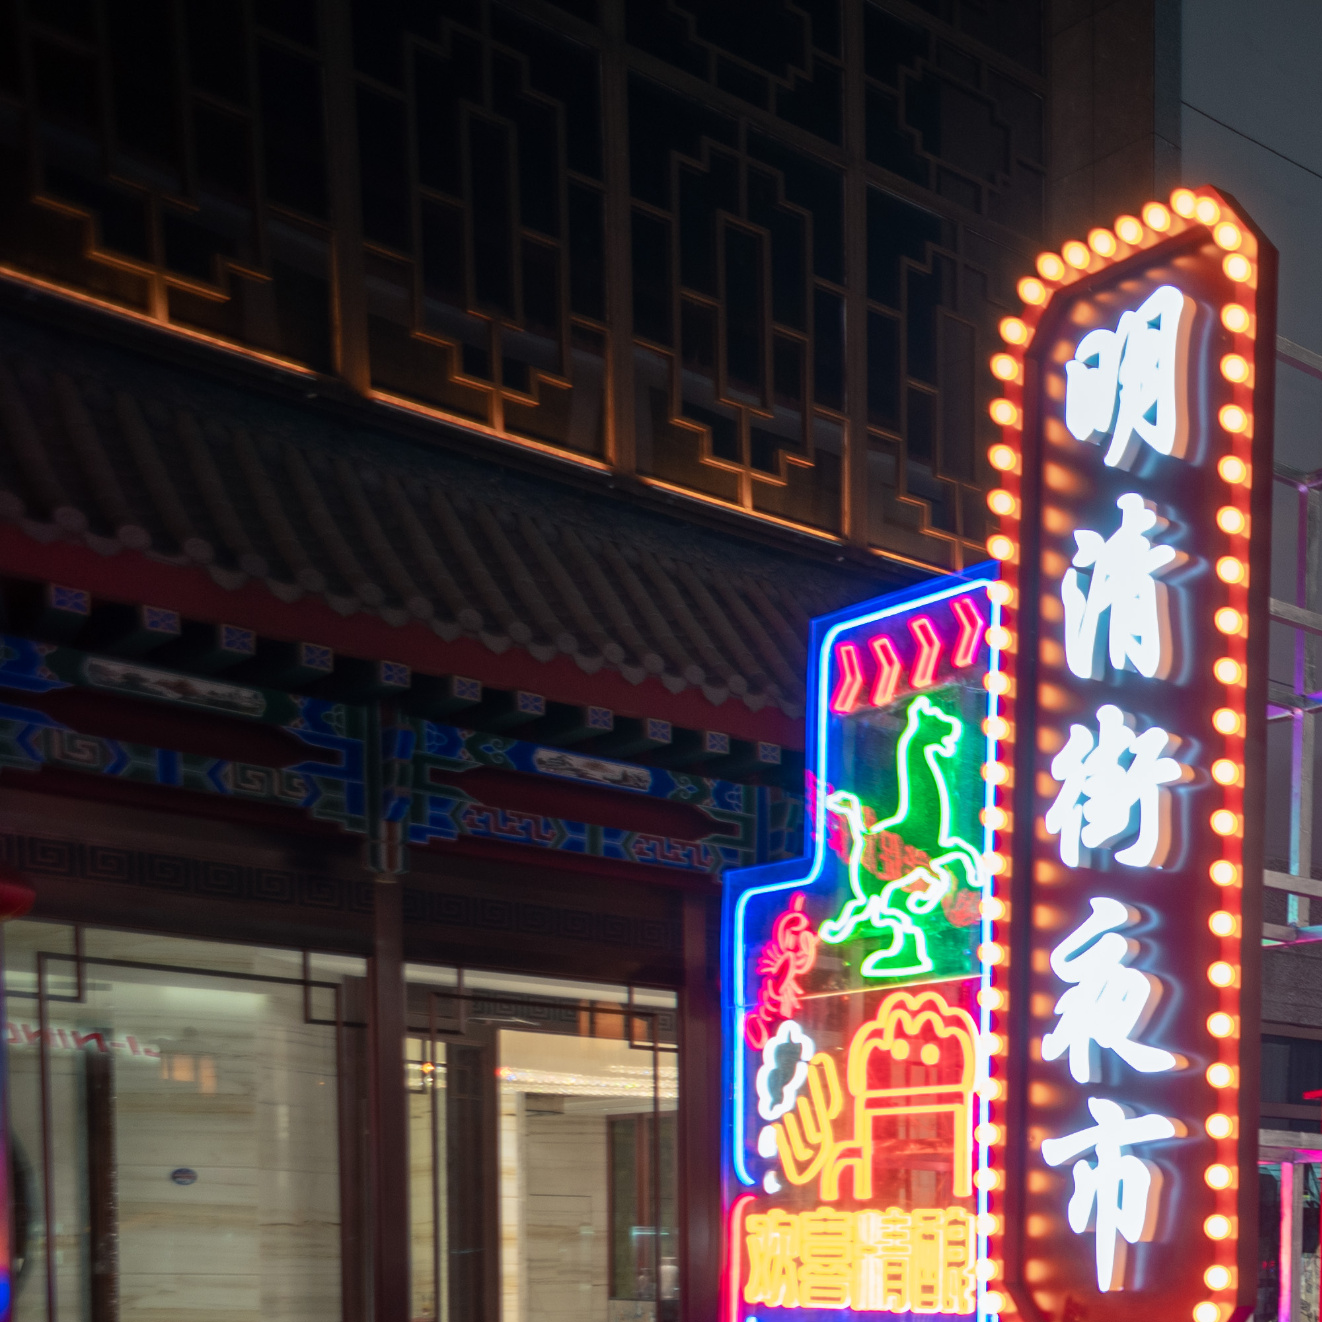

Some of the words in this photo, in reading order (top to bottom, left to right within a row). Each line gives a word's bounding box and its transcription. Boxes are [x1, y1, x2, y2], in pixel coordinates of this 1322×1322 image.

[1041, 285, 1184, 1292] 明清街夜市
